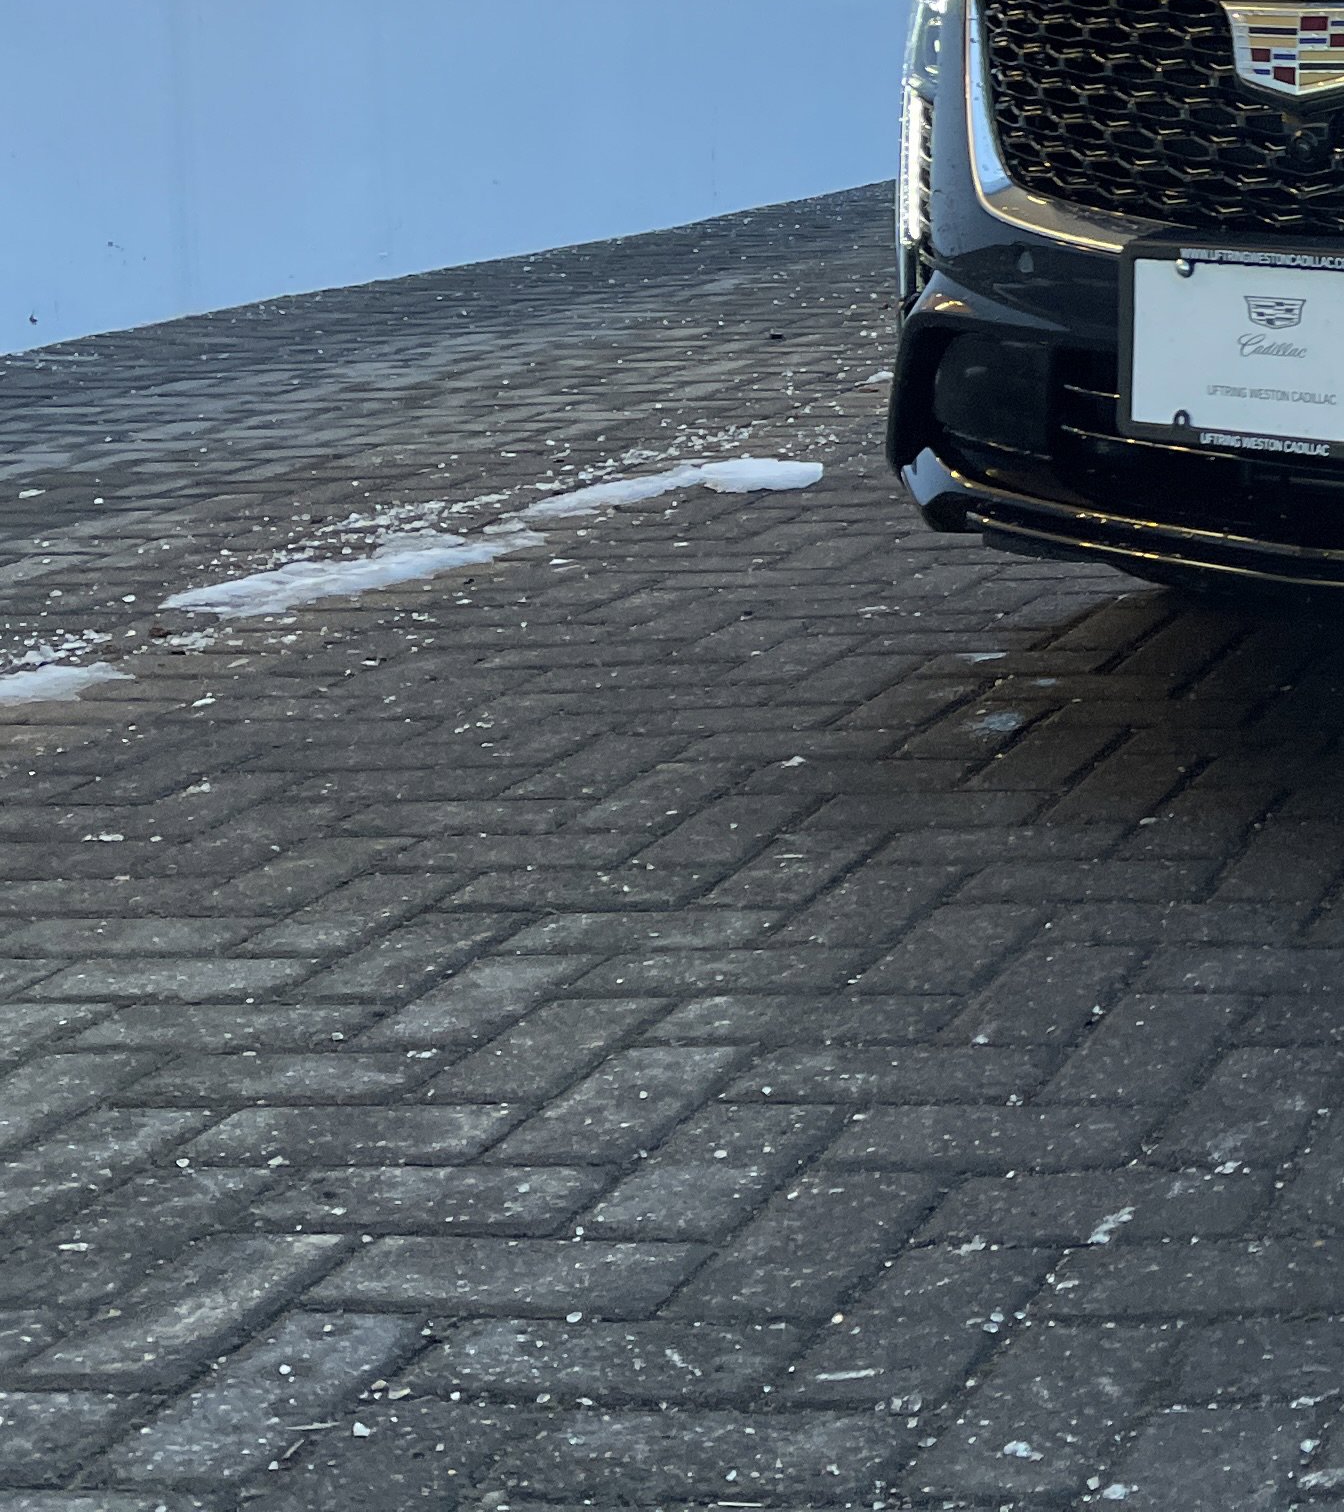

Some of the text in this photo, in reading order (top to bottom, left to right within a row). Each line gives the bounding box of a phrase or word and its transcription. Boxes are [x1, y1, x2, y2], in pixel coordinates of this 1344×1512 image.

[1237, 332, 1308, 359] Cadillac
[1249, 388, 1290, 402] WESTON
[1291, 391, 1337, 406] CADILLAC
[1242, 436, 1283, 452] WESTON
[1284, 440, 1330, 457] CADILLAC
